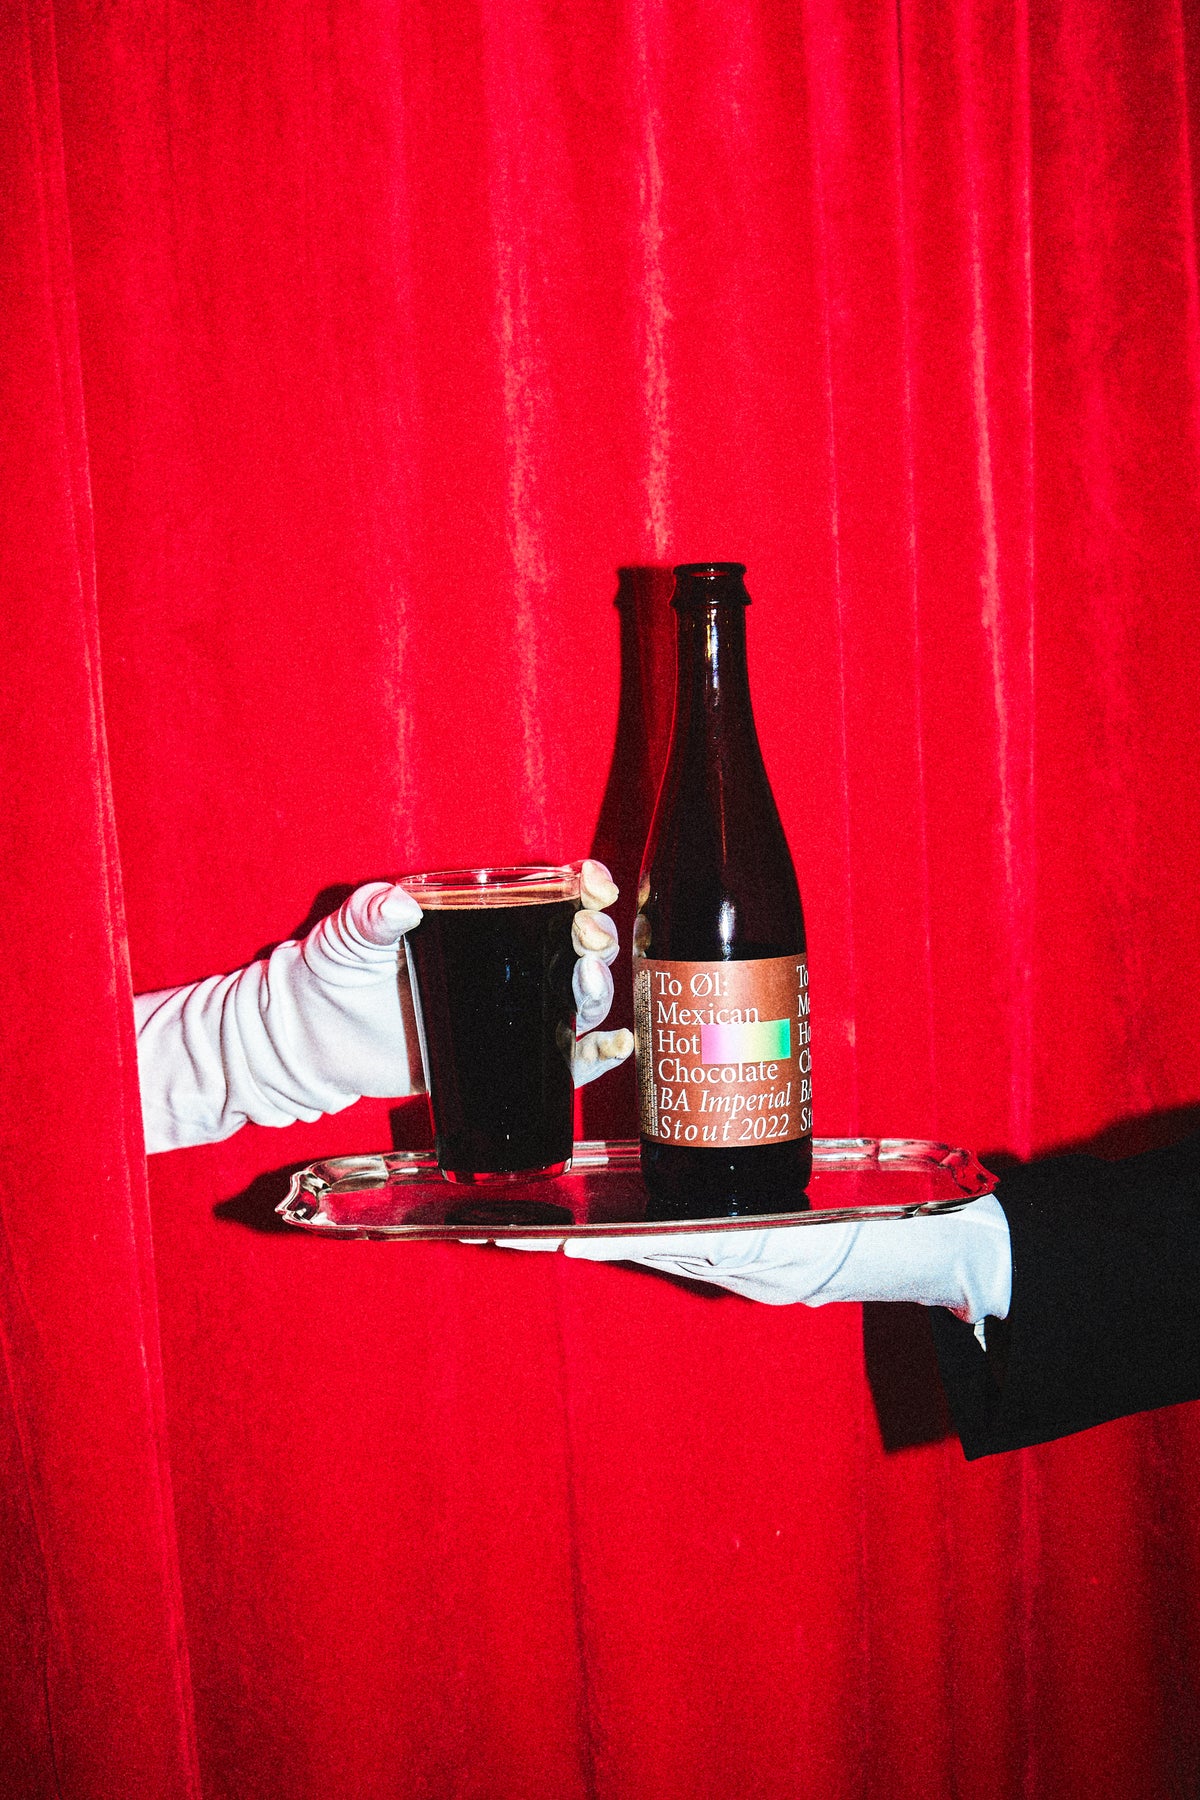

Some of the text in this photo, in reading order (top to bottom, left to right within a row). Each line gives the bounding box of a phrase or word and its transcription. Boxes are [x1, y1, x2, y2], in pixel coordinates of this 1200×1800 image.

[655, 971, 728, 997] To Øl:
[796, 964, 808, 988] To
[656, 1001, 760, 1025] Mexican
[657, 1029, 700, 1054] Hot
[658, 1058, 778, 1083] Chocolate
[660, 1082, 791, 1119] BA Imperial
[660, 1113, 789, 1141] Stout 2022
